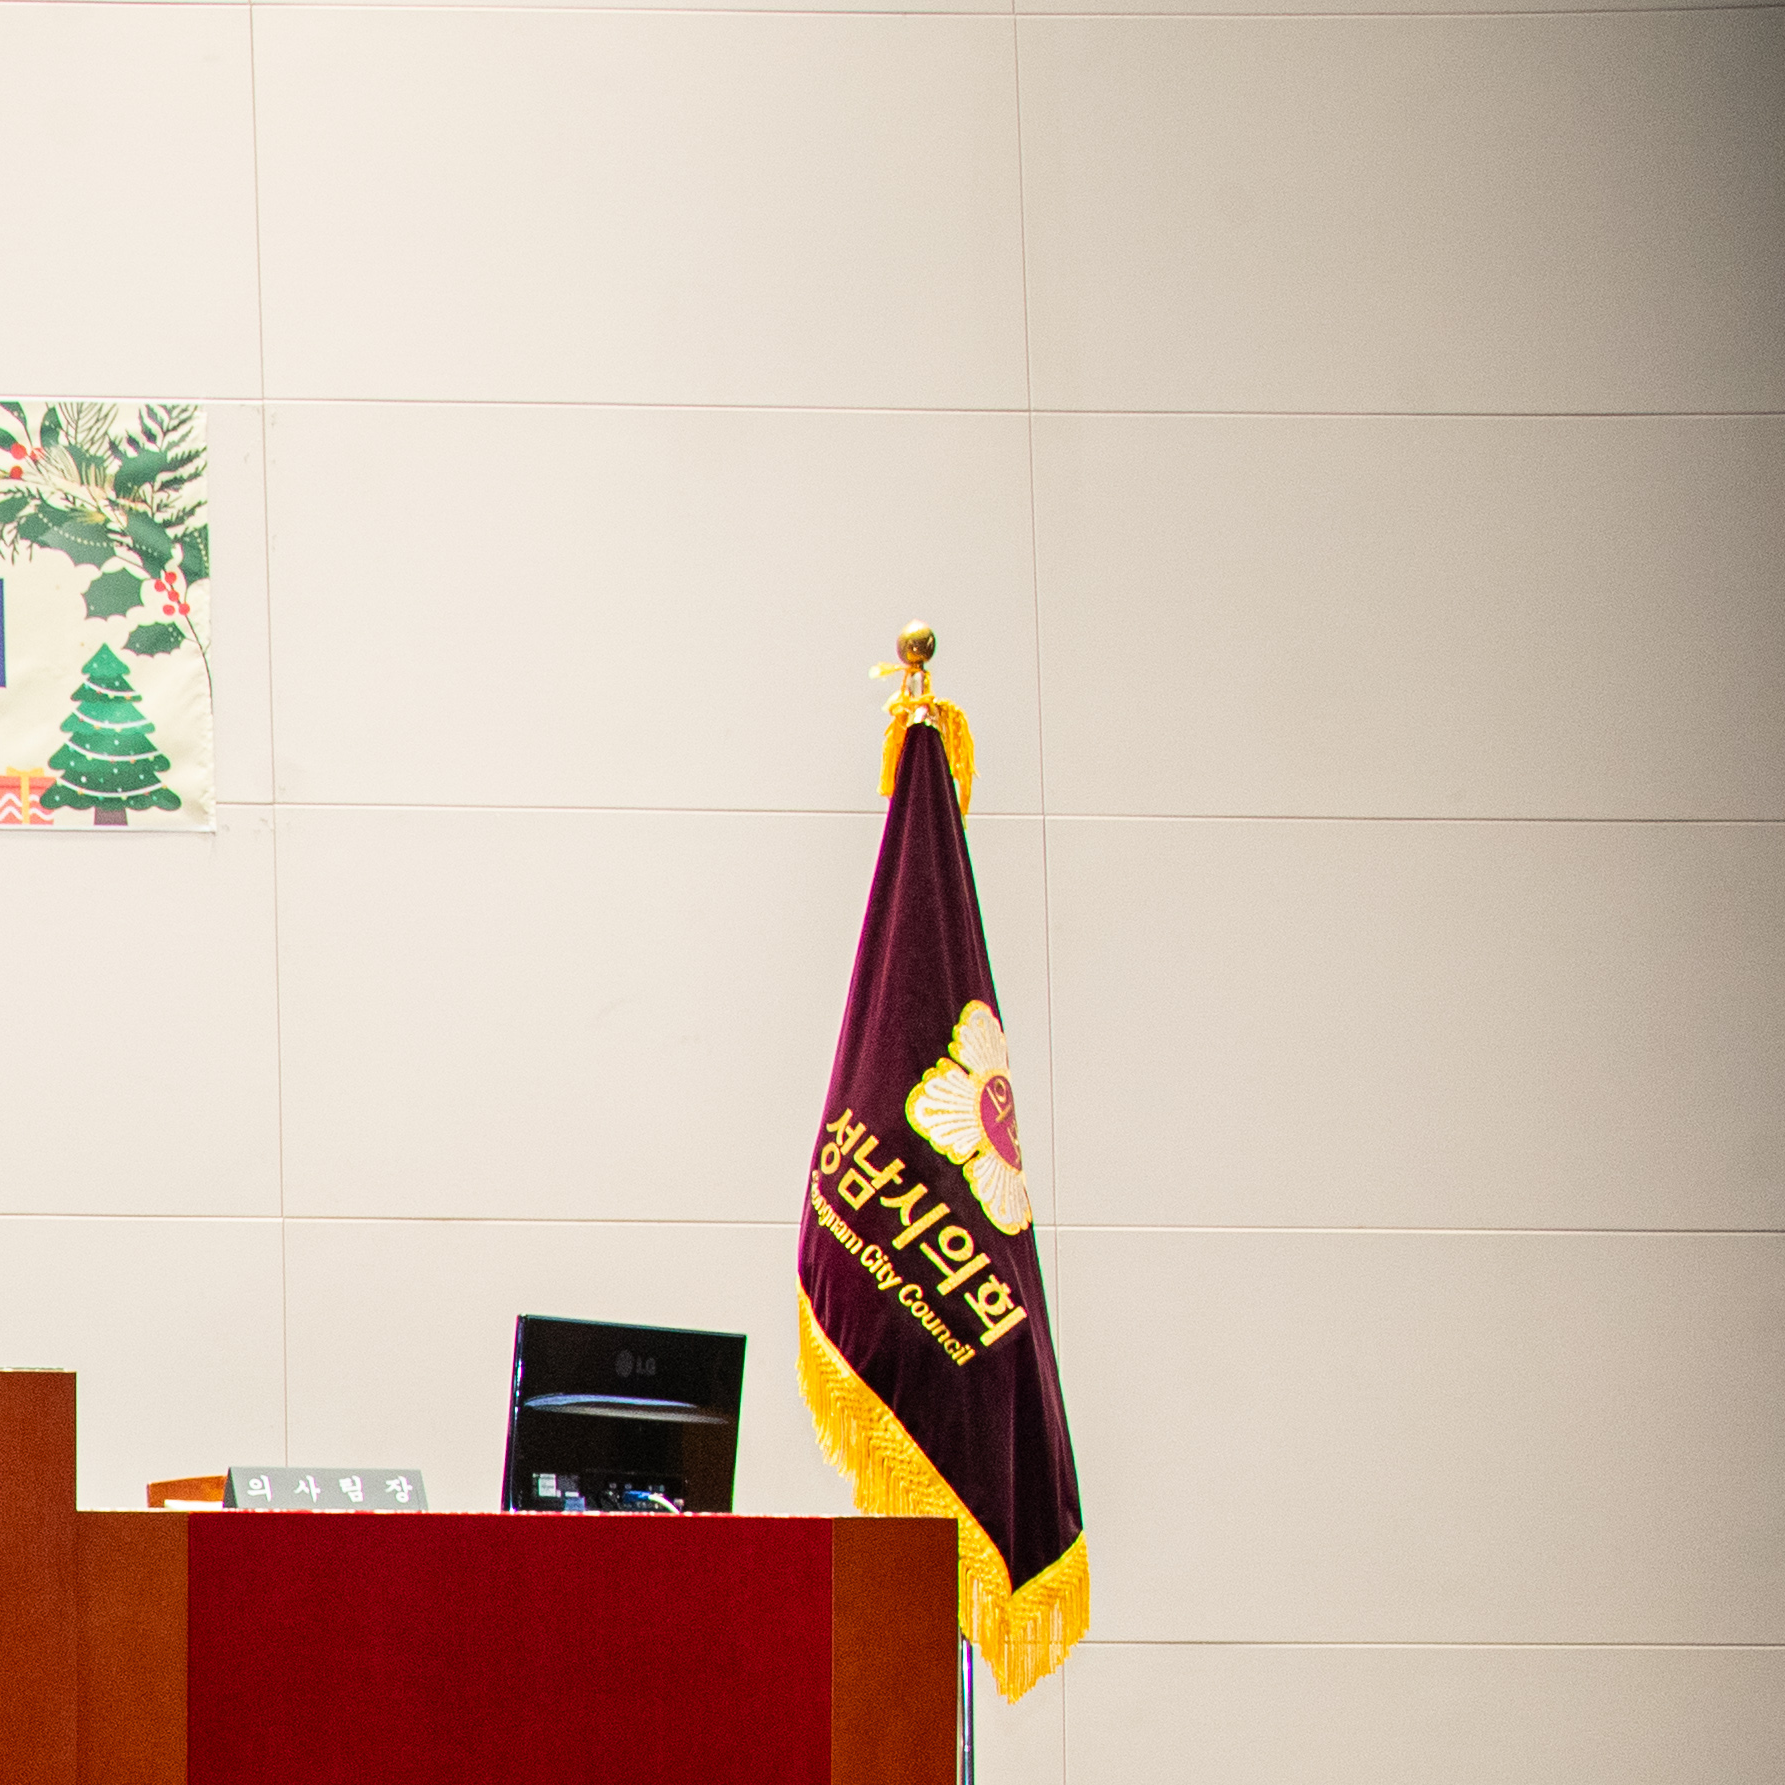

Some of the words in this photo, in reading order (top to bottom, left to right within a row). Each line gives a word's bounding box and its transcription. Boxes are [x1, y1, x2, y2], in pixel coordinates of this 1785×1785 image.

[820, 1108, 1028, 1347] 성남시의회
[860, 1244, 904, 1291] City
[898, 1283, 977, 1367] Council
